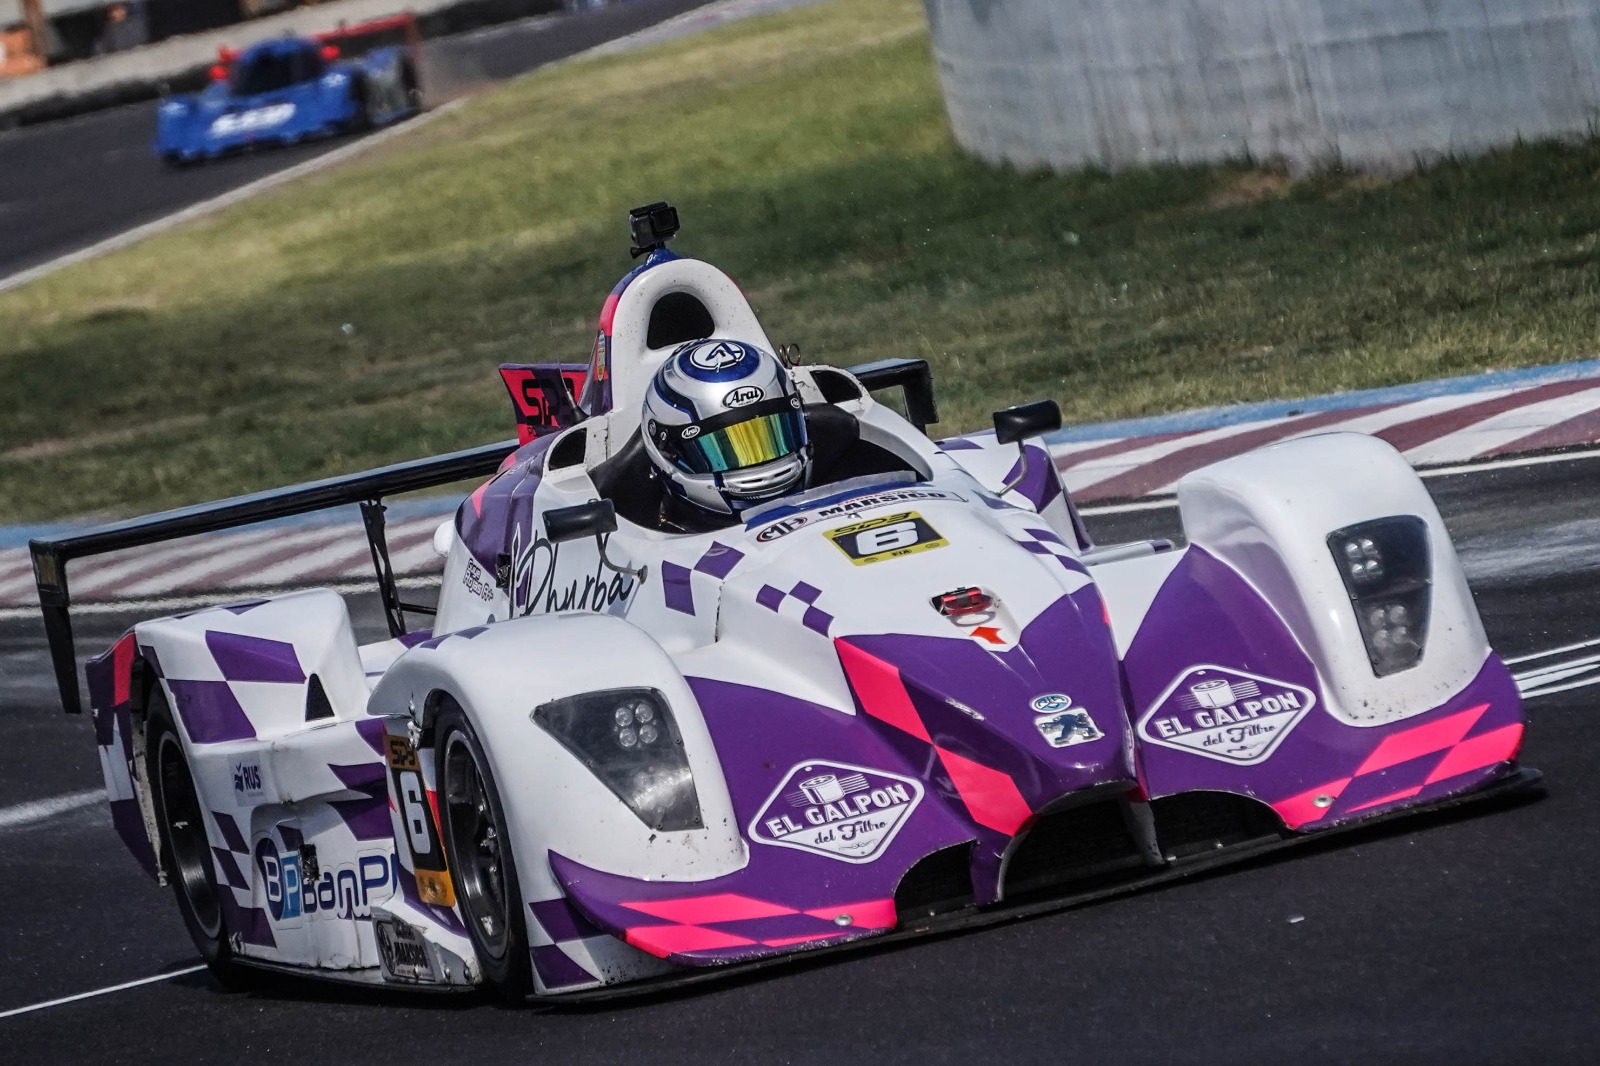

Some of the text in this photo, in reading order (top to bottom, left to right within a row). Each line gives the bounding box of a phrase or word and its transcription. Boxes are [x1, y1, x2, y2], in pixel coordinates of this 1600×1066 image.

[727, 387, 759, 405] Arai
[819, 492, 947, 517] MARSICO
[856, 521, 919, 556] 6
[1155, 692, 1301, 738] EL GALPON
[1203, 724, 1277, 747] del Filtro
[242, 765, 262, 790] RUS
[400, 771, 431, 854] 6
[765, 784, 911, 838] EL GALPON
[815, 820, 888, 845] del Filtro
